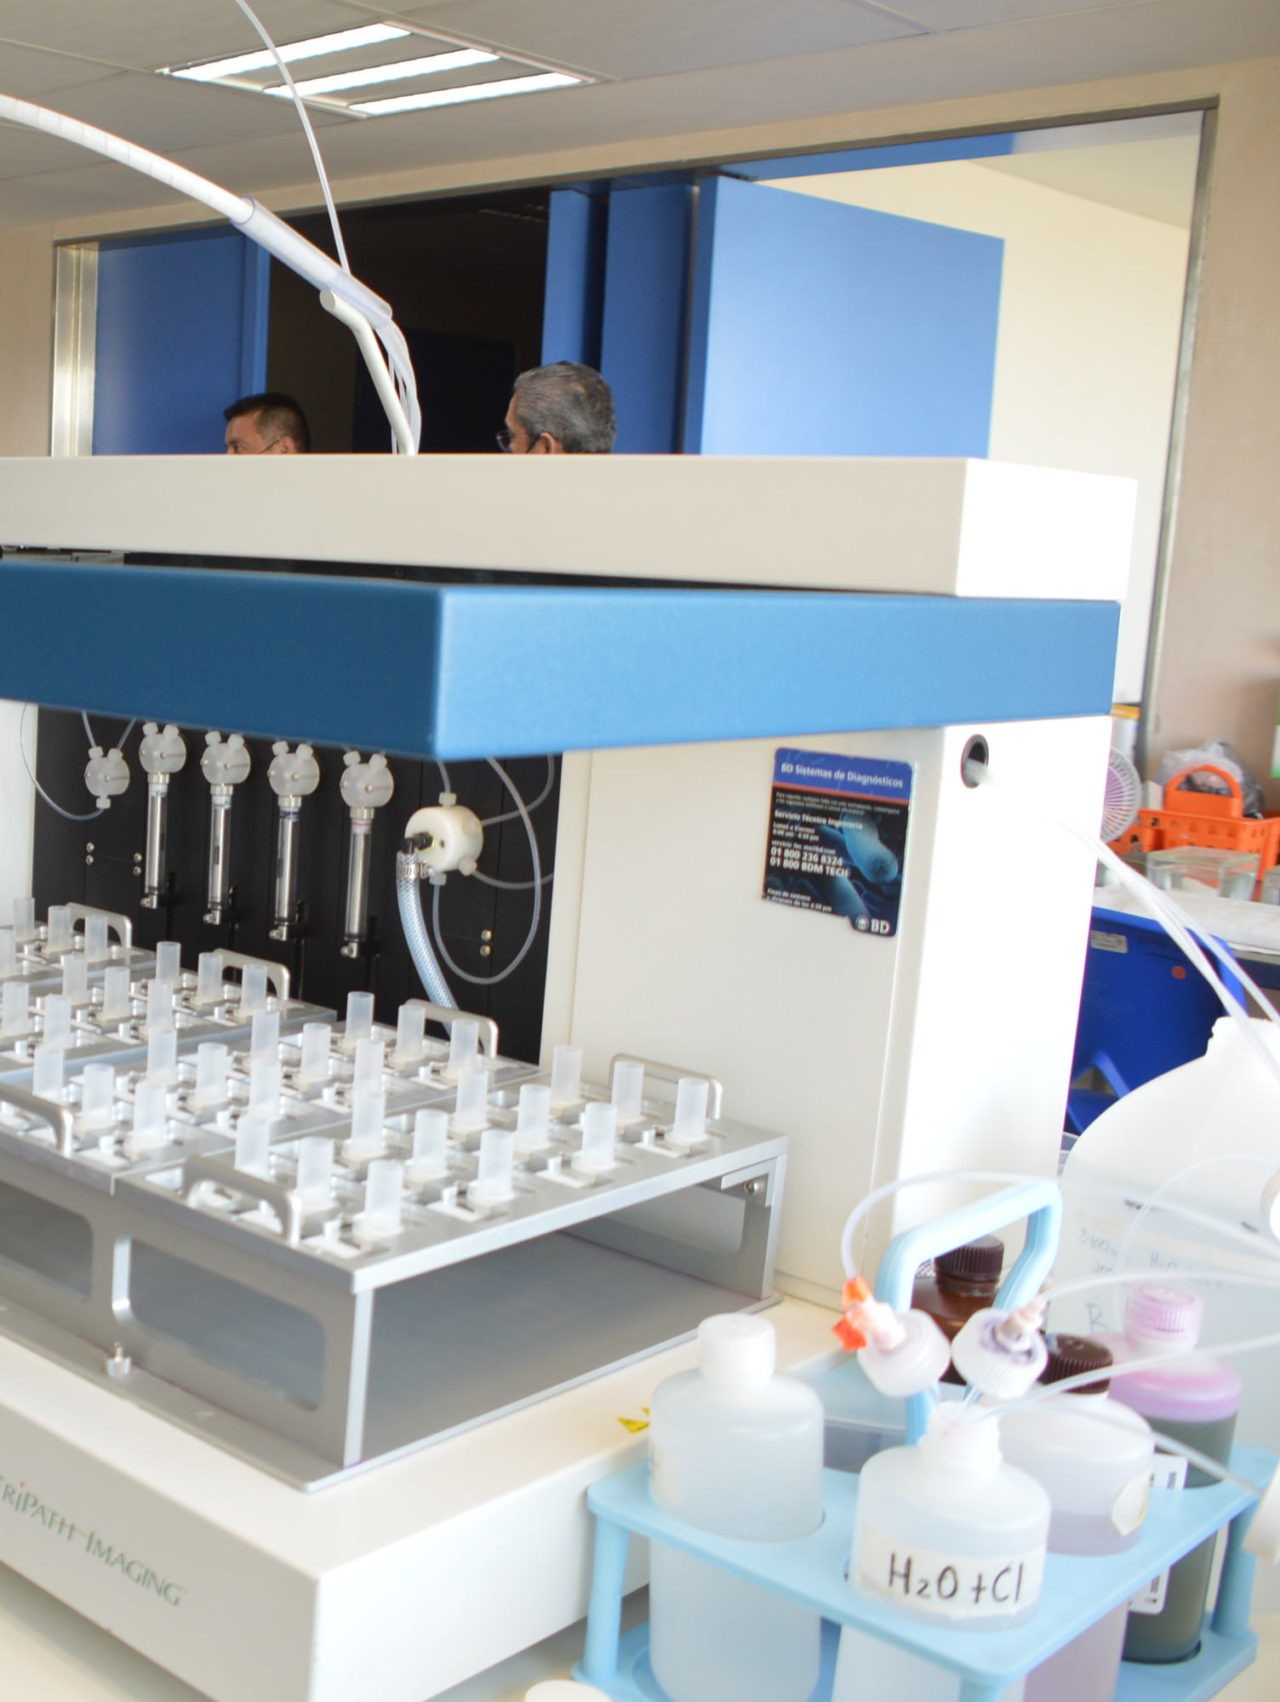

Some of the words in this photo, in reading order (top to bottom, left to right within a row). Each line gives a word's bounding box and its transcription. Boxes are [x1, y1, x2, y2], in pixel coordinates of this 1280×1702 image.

[781, 763, 793, 773] BD
[795, 764, 832, 779] Sistemas
[834, 769, 845, 780] de
[847, 771, 903, 789] Diagnósticos
[774, 810, 800, 819] Servicio
[771, 847, 781, 857] 01
[784, 849, 800, 859] 800
[802, 852, 819, 863] 236
[821, 855, 843, 867] 8324
[770, 857, 780, 867] 01
[783, 859, 799, 870] 800
[801, 862, 823, 875] BDM
[825, 865, 849, 879] TECH
[871, 918, 890, 934] BD
[84, 1531, 181, 1606] IMAGING
